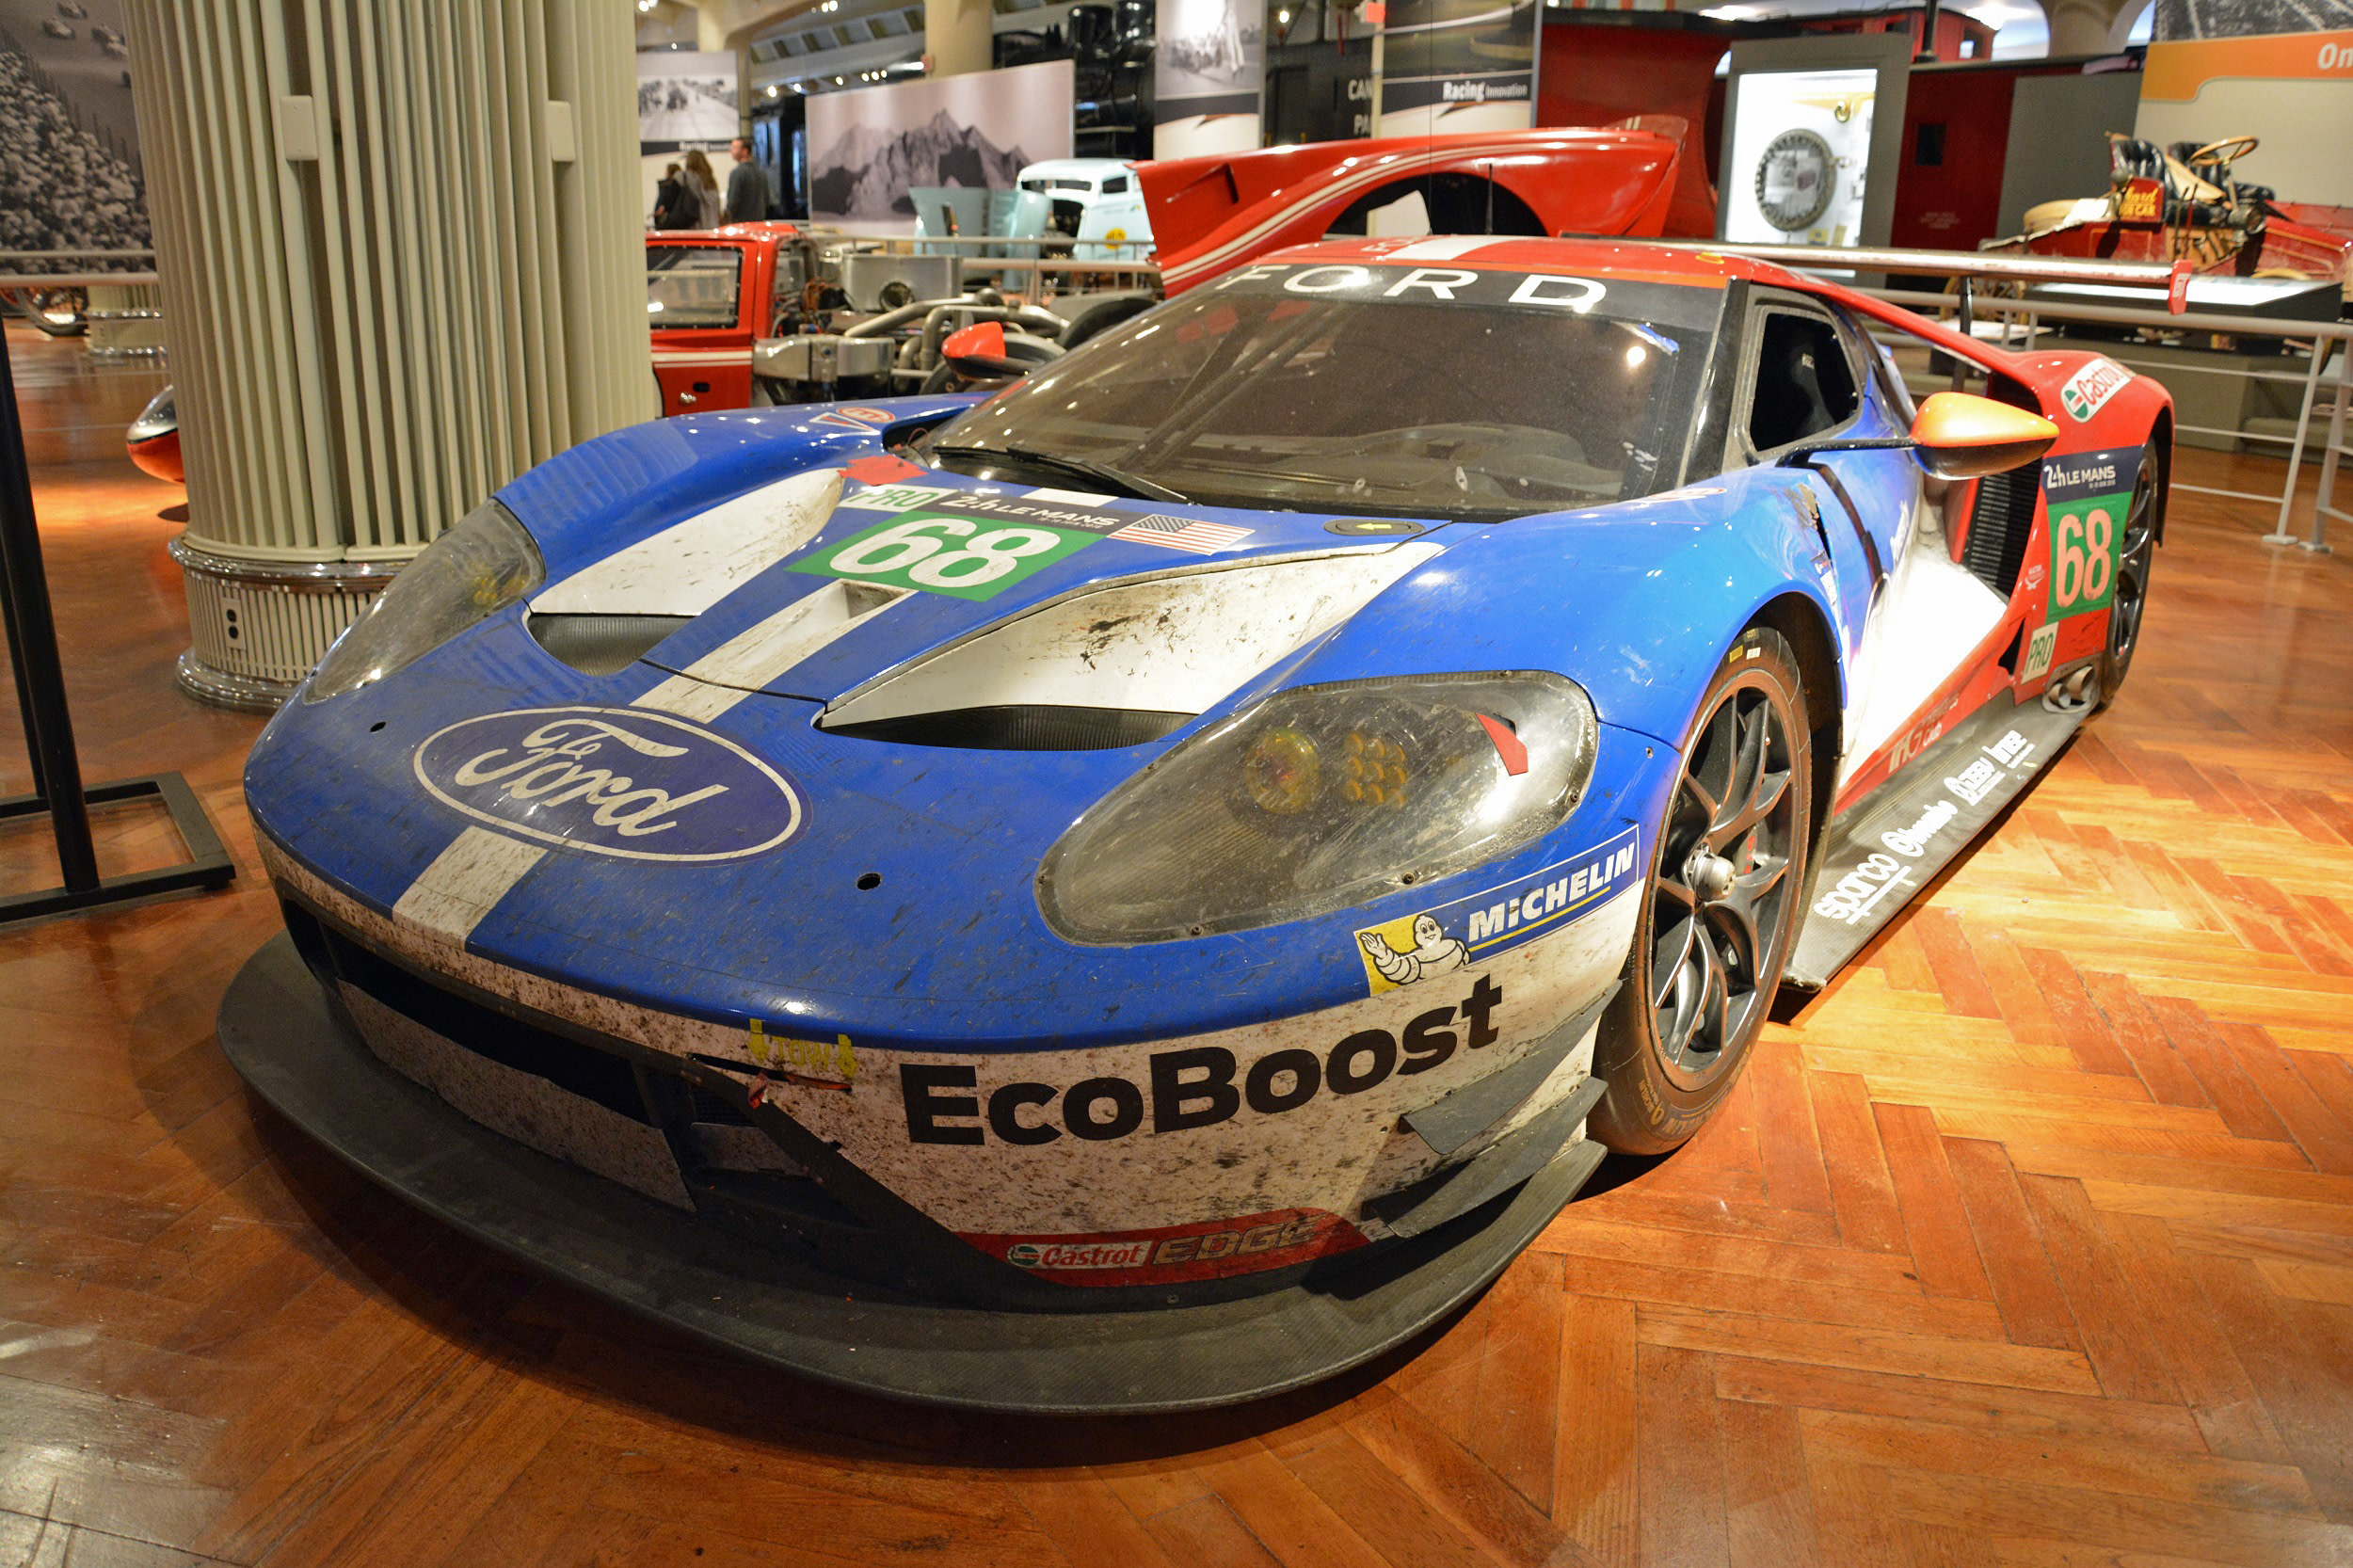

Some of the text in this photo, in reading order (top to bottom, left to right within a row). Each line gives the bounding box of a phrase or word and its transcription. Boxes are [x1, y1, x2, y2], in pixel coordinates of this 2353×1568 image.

[1443, 81, 1528, 102] Racing innovation
[1215, 264, 1608, 308] FORD
[846, 488, 939, 506] PRO
[2066, 471, 2080, 486] LE
[2081, 466, 2116, 483] MANS
[994, 505, 1036, 515] LE
[1031, 509, 1120, 526] MANS
[829, 518, 1061, 587] 68
[2056, 508, 2113, 608] 68
[2025, 632, 2055, 674] PRO
[455, 718, 729, 837] Ford
[1468, 841, 1634, 943] MICHELIN
[1813, 853, 1902, 921] sparco
[773, 1036, 831, 1071] TOW
[900, 974, 1503, 1146] EcoBoost
[1041, 1212, 1328, 1267] Castrol EDGE
